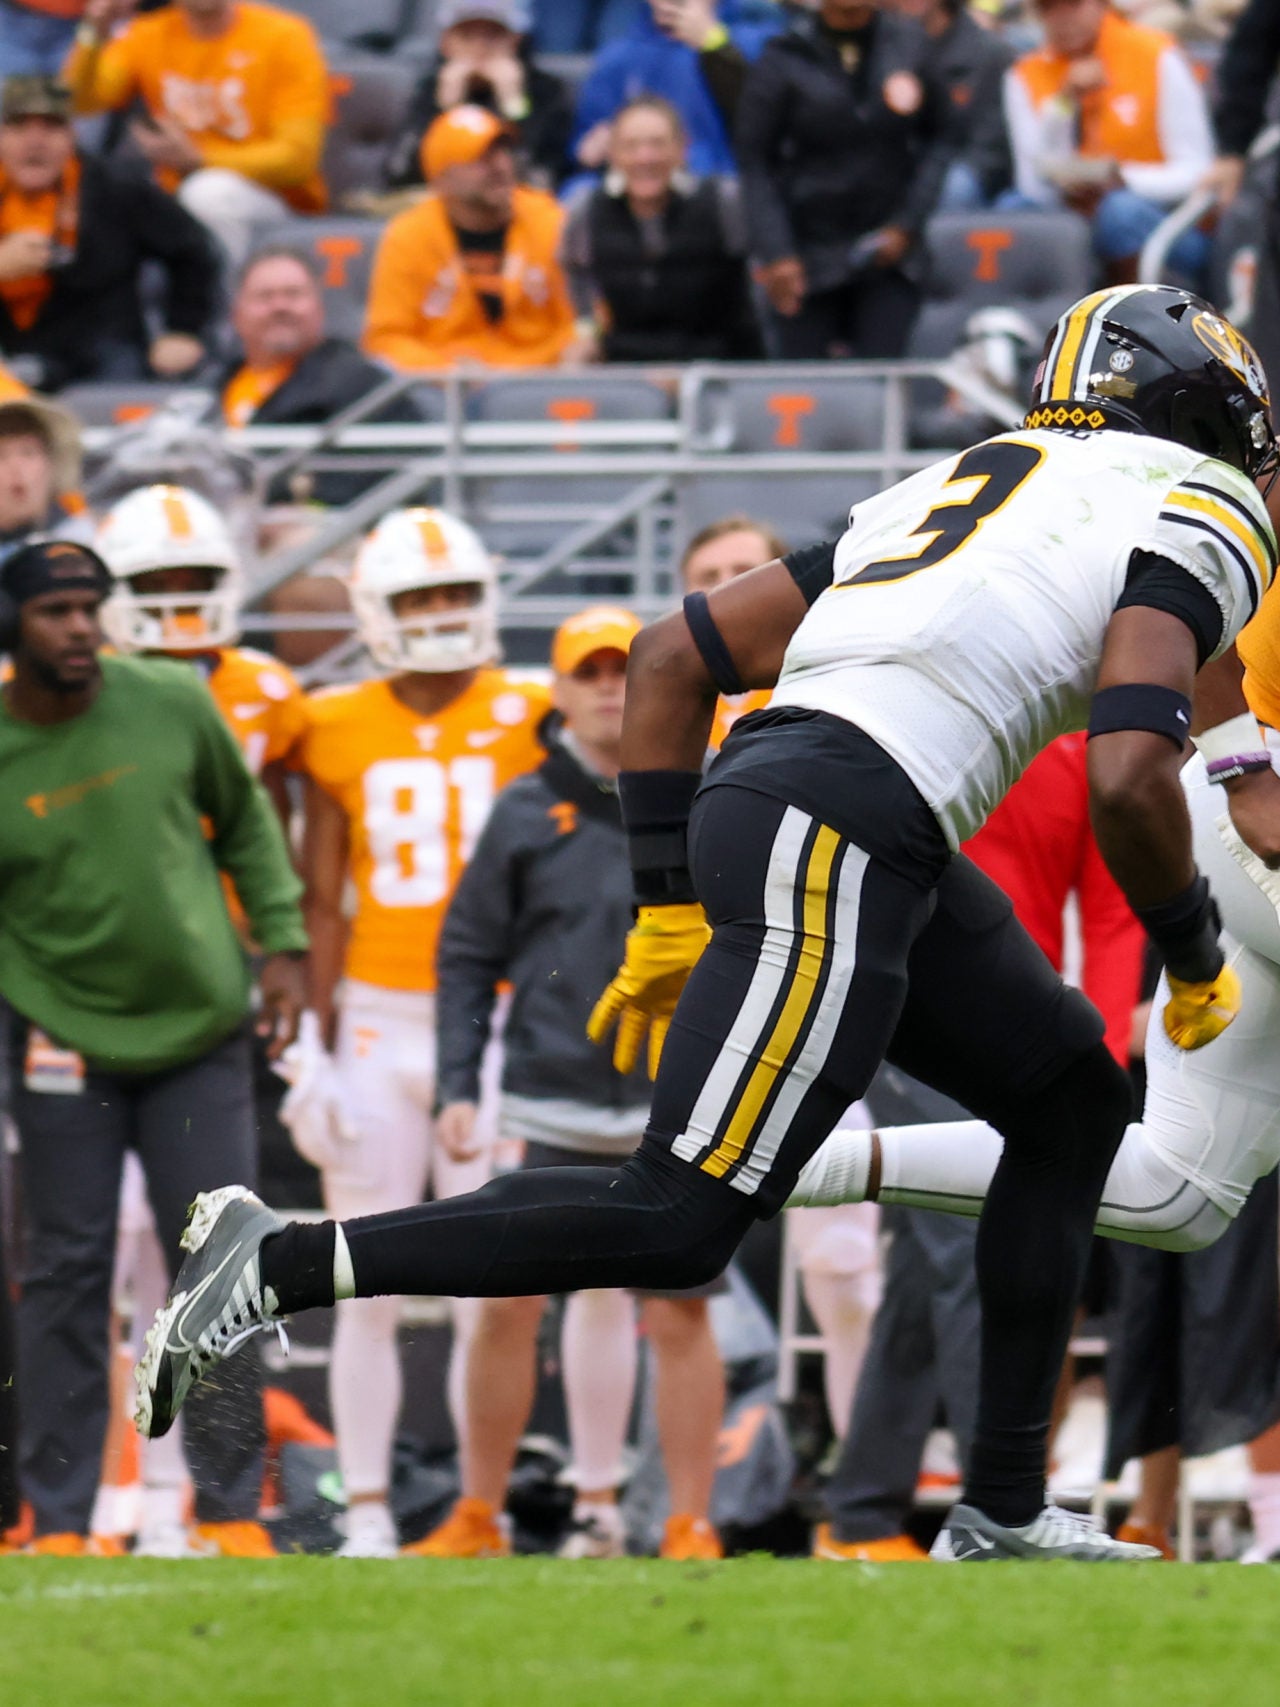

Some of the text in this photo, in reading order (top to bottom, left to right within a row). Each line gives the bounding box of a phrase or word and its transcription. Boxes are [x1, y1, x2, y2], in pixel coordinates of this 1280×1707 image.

[966, 230, 1013, 281] T
[766, 395, 814, 446] T
[829, 438, 1048, 590] 3
[364, 757, 494, 907] 81
